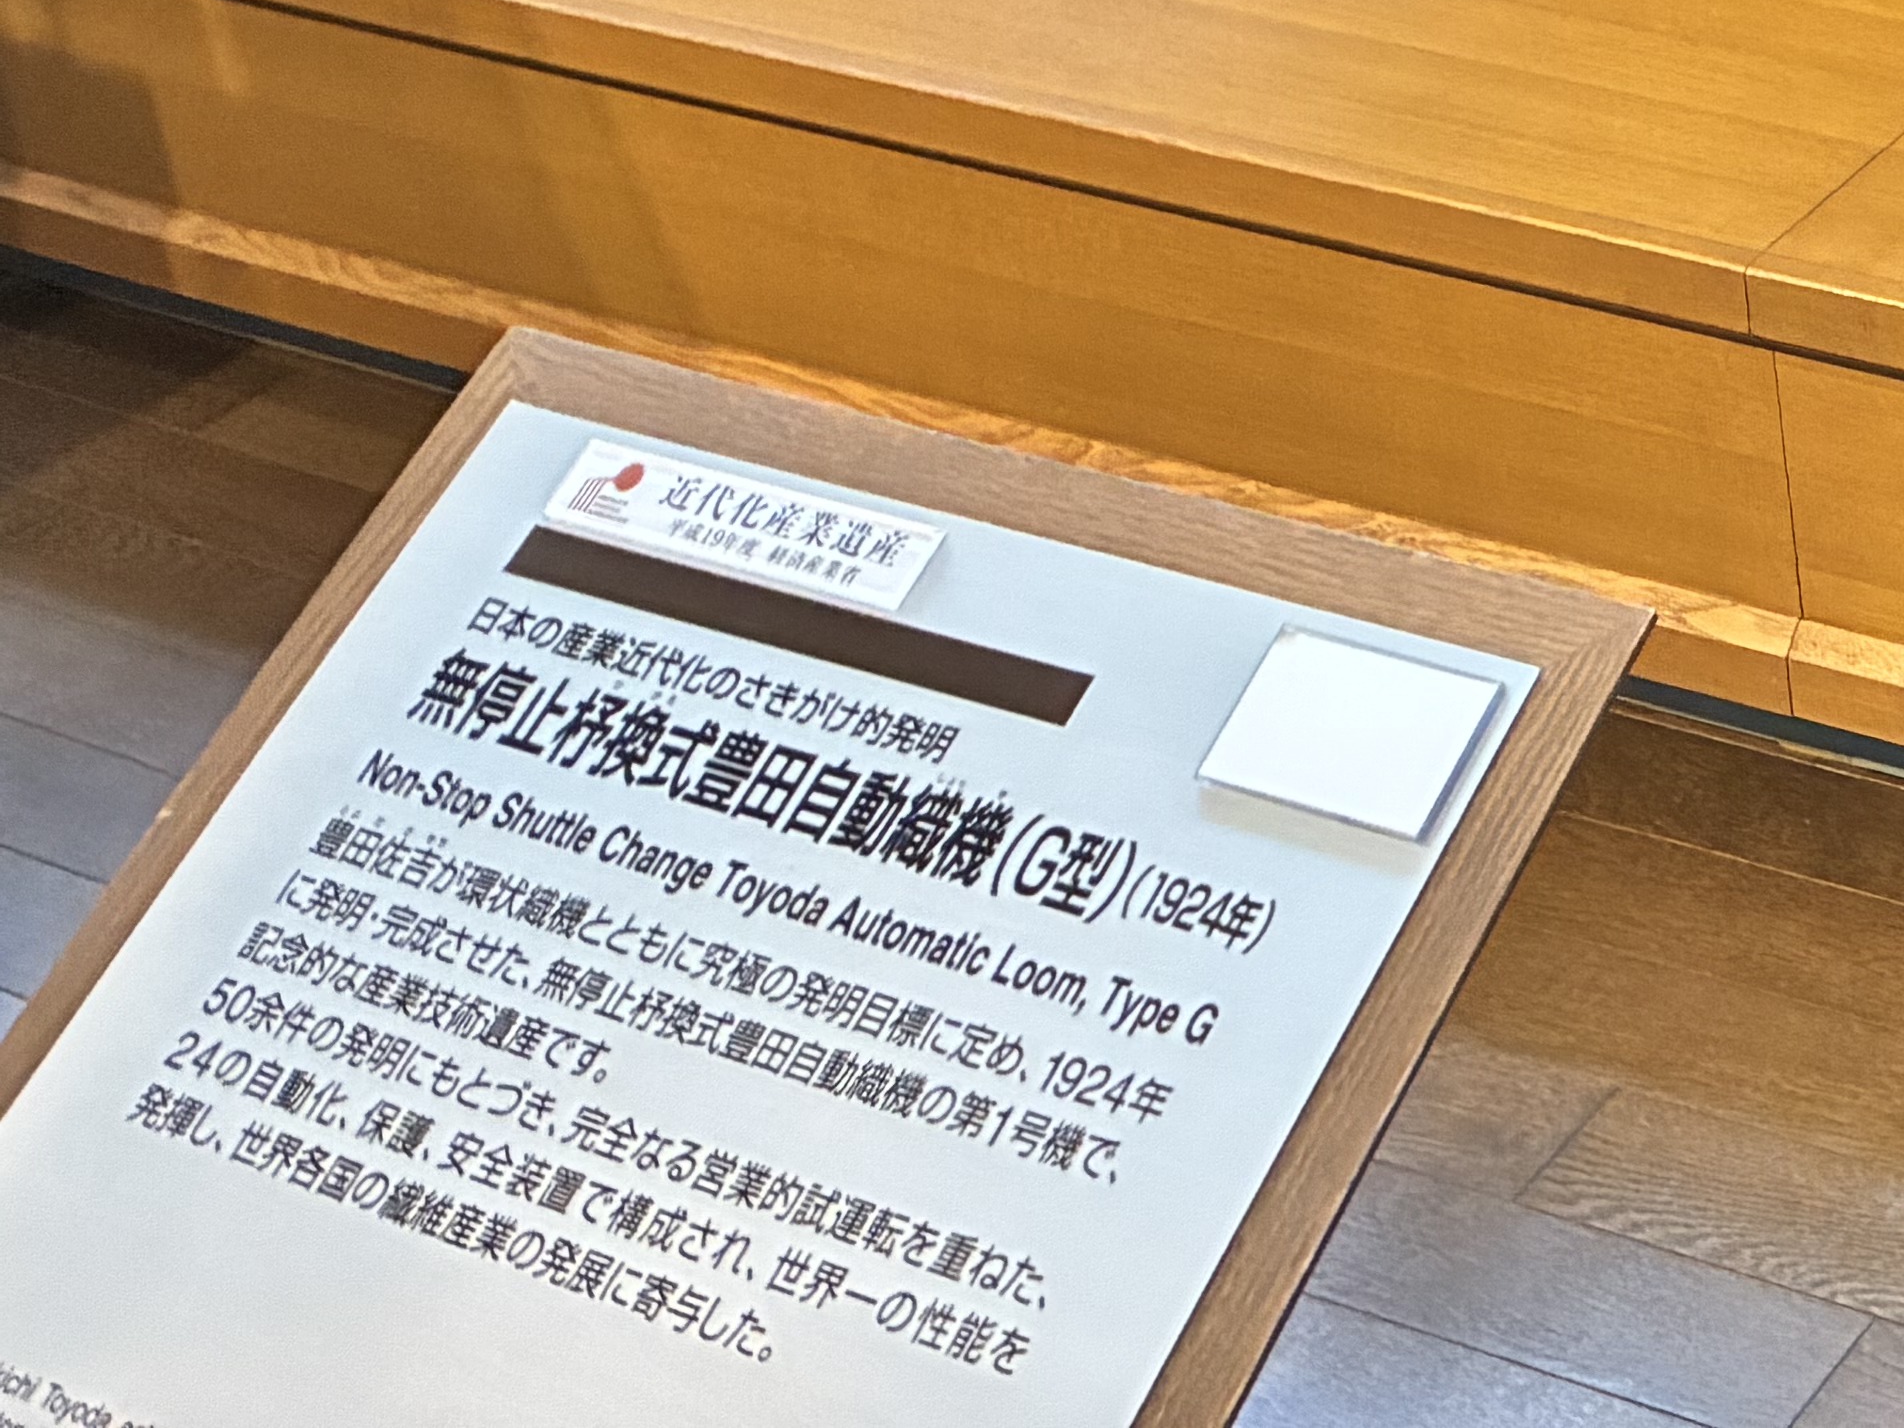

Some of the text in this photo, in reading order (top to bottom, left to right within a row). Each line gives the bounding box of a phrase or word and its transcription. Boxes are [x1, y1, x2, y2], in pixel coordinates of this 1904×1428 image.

[659, 475, 909, 567] 近代化産業遺産
[466, 595, 962, 764] 日本の産業近代化のさきがけ的発明
[356, 748, 492, 827] Non-Stop
[491, 791, 599, 856] Shuttle
[599, 824, 714, 895] Change
[715, 858, 831, 926] Toyoda
[826, 896, 992, 977] Automatic
[990, 942, 1089, 1016] Loom,
[1098, 974, 1181, 1039] Type
[1184, 1002, 1220, 1047] G
[236, 920, 612, 1084] 記念的な産業技術遺産です。
